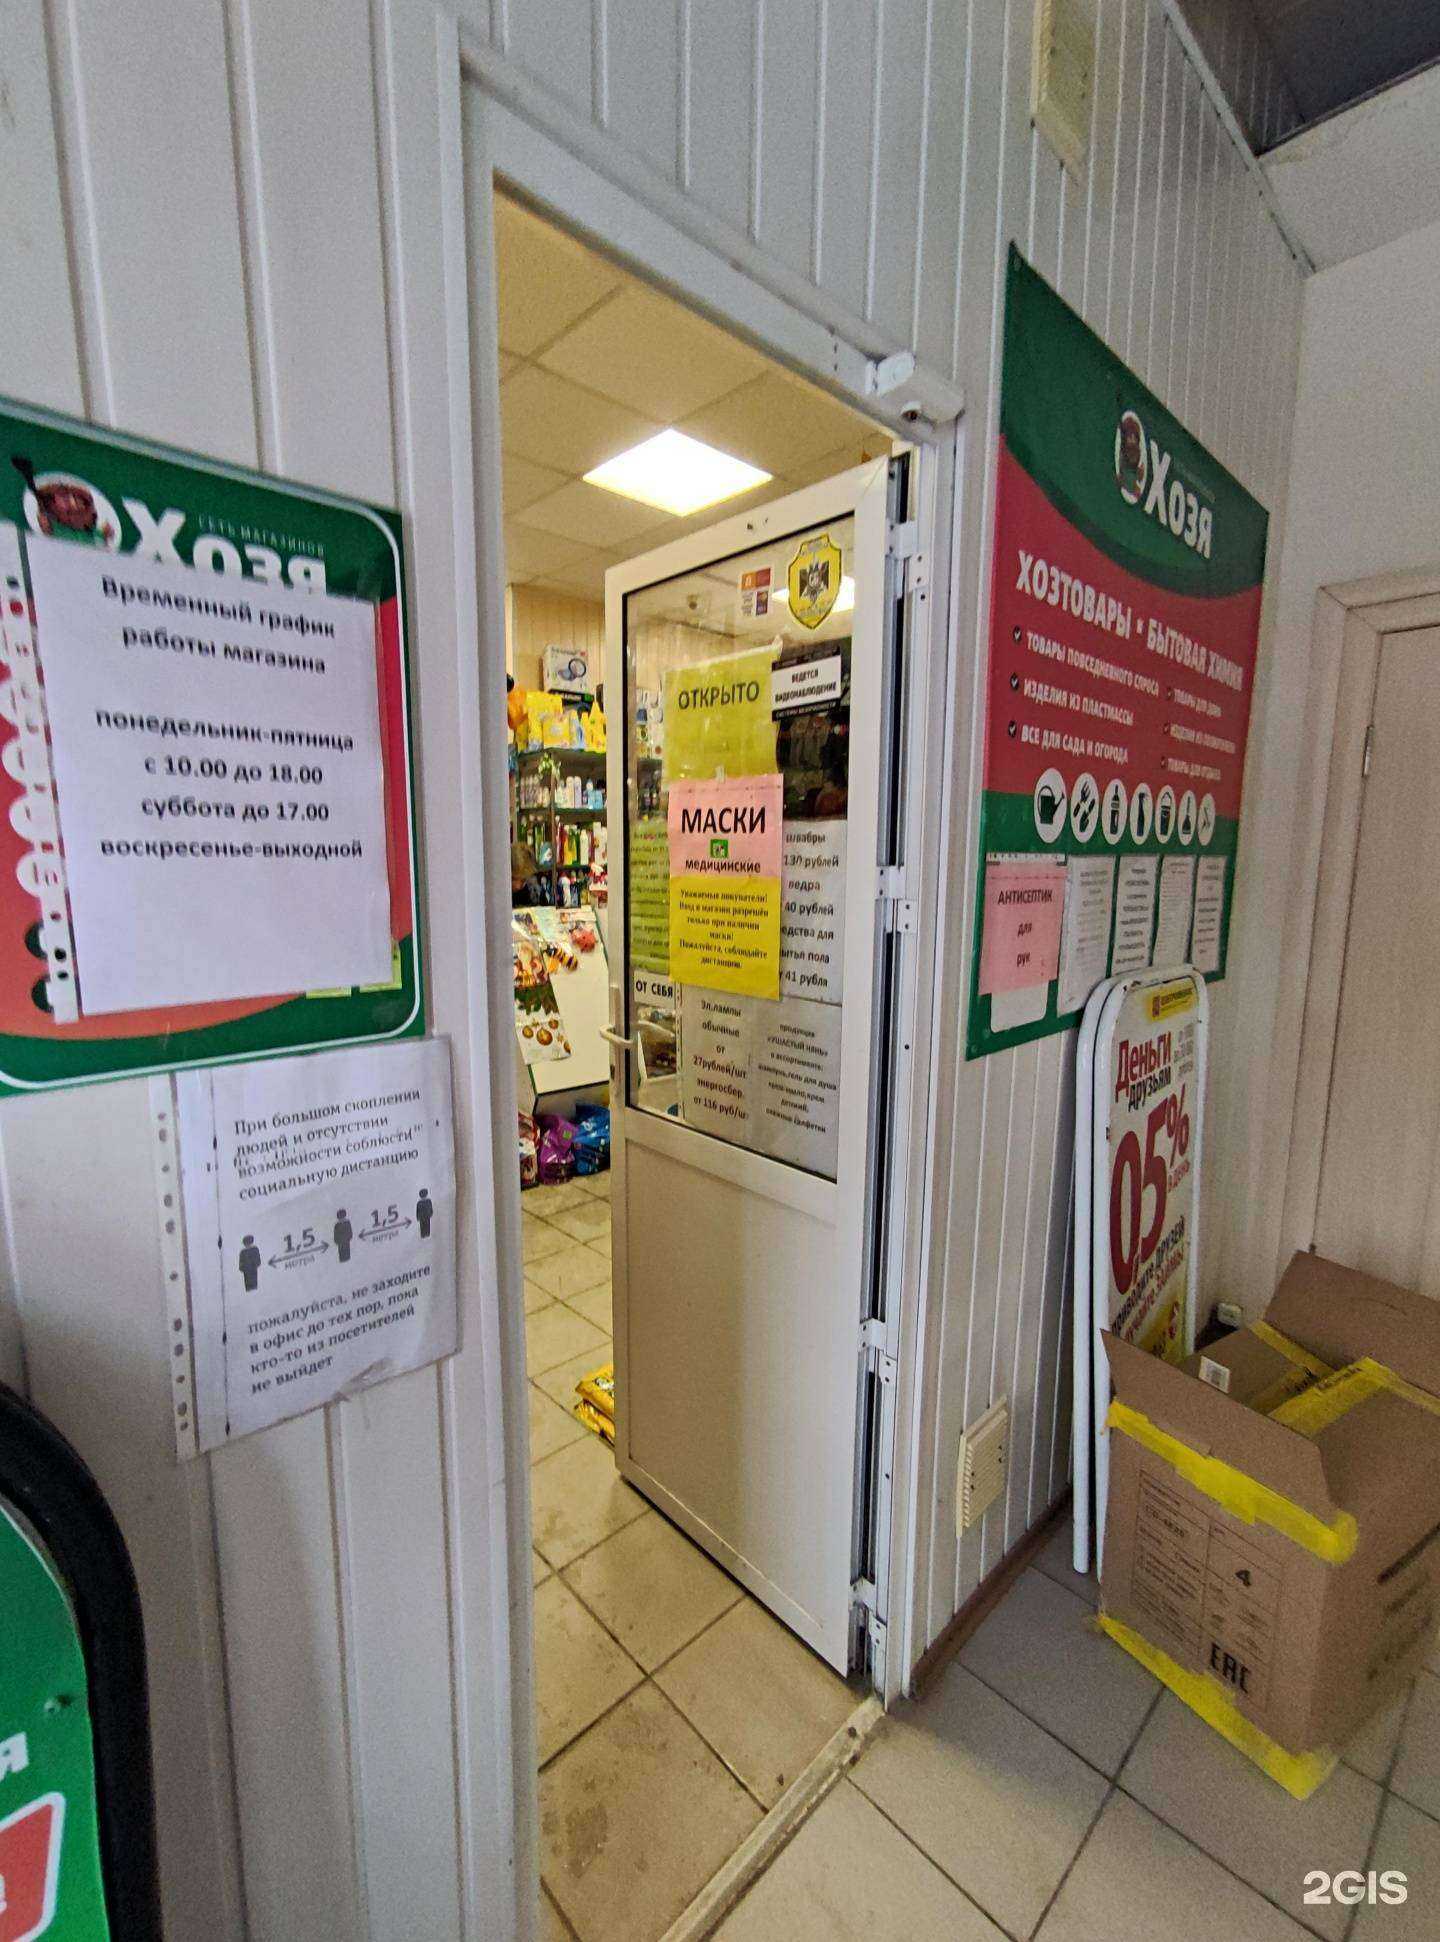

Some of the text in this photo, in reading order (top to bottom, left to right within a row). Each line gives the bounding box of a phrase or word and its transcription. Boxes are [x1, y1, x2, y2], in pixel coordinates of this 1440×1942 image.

[101, 575, 336, 639] Временный график
[1016, 550, 1132, 639] ХОЗТОВАРЫ
[1147, 619, 1207, 674] БЫТОВАЯ
[122, 625, 326, 674] работы магазина
[1027, 632, 1066, 662] ТОВАРЫ
[678, 681, 760, 711] ОТКРЫТО
[1024, 678, 1068, 707] ИЗДЕЛИЯ
[1069, 691, 1081, 711] ИЗ
[96, 709, 354, 752] понедельник-пятница
[1021, 724, 1129, 765] ВСЕ ДЛЯ САДА И ОГОРОДА
[144, 755, 324, 785] с 10.00 до 18.00
[141, 796, 329, 823] суббота до 17.00
[681, 806, 766, 834] МАСКИ
[101, 838, 363, 860] воскресенье-выходной
[786, 831, 826, 846] швабры
[685, 857, 761, 873] медицинские
[804, 854, 839, 871] рублей
[788, 880, 821, 892] ведра
[998, 889, 1053, 905] АНТИСЕПТИК
[799, 902, 834, 918] рублей
[781, 925, 834, 941] едства для
[780, 951, 830, 965] ытья пола
[1017, 952, 1031, 967] рук
[635, 980, 673, 998] ОТ СЕБЯ
[800, 972, 828, 987] рубля
[716, 1045, 725, 1054] от
[1115, 1031, 1171, 1103] Деньги
[804, 1076, 817, 1086] для
[818, 1081, 837, 1091] душа
[234, 1088, 422, 1137] При большом скоплении
[236, 1114, 389, 1159] людей и отсутствии
[238, 1128, 413, 1181] возможности соблюсти
[239, 1148, 419, 1201] социальную дистанцию
[283, 1204, 400, 1254] 1,5 1,5
[248, 1265, 432, 1335] пожалуйста, не заходите
[249, 1287, 420, 1355] в офис до тех пор, пока
[250, 1305, 416, 1376] кто-то из посетителей
[252, 1354, 334, 1396] не выйдет
[1235, 1569, 1252, 1587] 4
[1210, 1641, 1251, 1695] EAC
